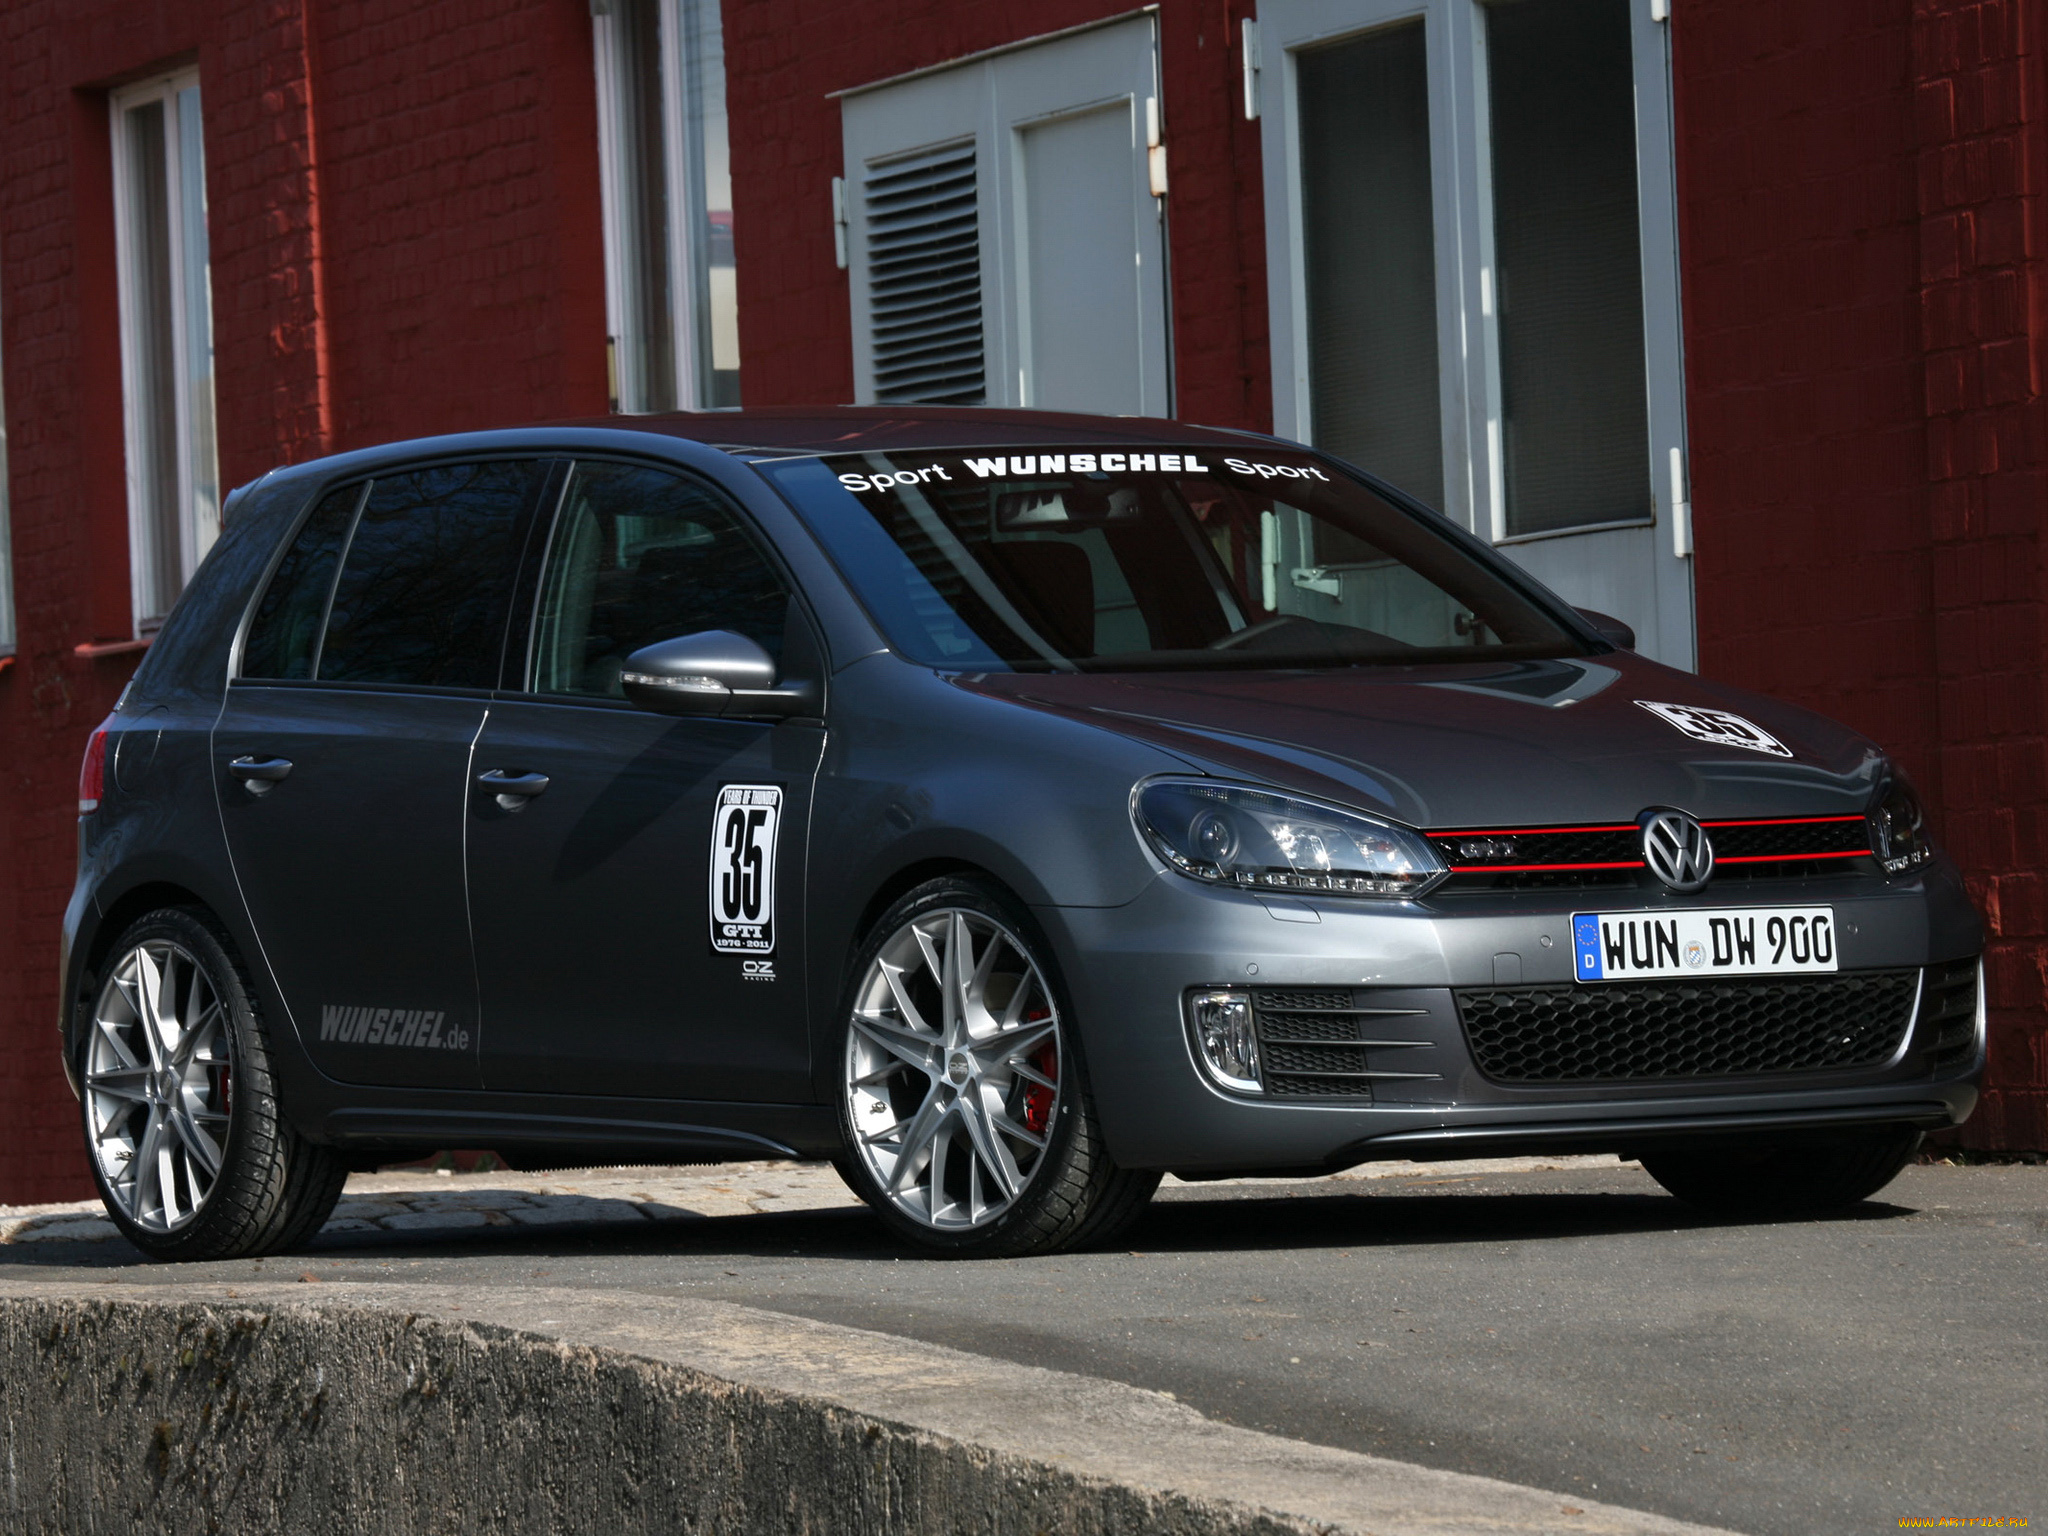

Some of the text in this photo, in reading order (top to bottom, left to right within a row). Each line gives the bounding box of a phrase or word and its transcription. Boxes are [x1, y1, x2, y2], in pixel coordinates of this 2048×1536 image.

[838, 454, 1330, 493] Sport WUNSCHEL Sport
[1664, 707, 1761, 741] 35
[724, 789, 778, 806] YEARS OF THUNDER
[721, 807, 768, 921] 35
[716, 938, 770, 949] 1976 2011
[722, 924, 762, 938] GTI
[1602, 919, 1680, 971] WUN
[1709, 917, 1755, 966] DW
[1766, 915, 1832, 964] 900
[1584, 954, 1595, 969] D
[320, 1004, 469, 1050] WUNSCHEL.de
